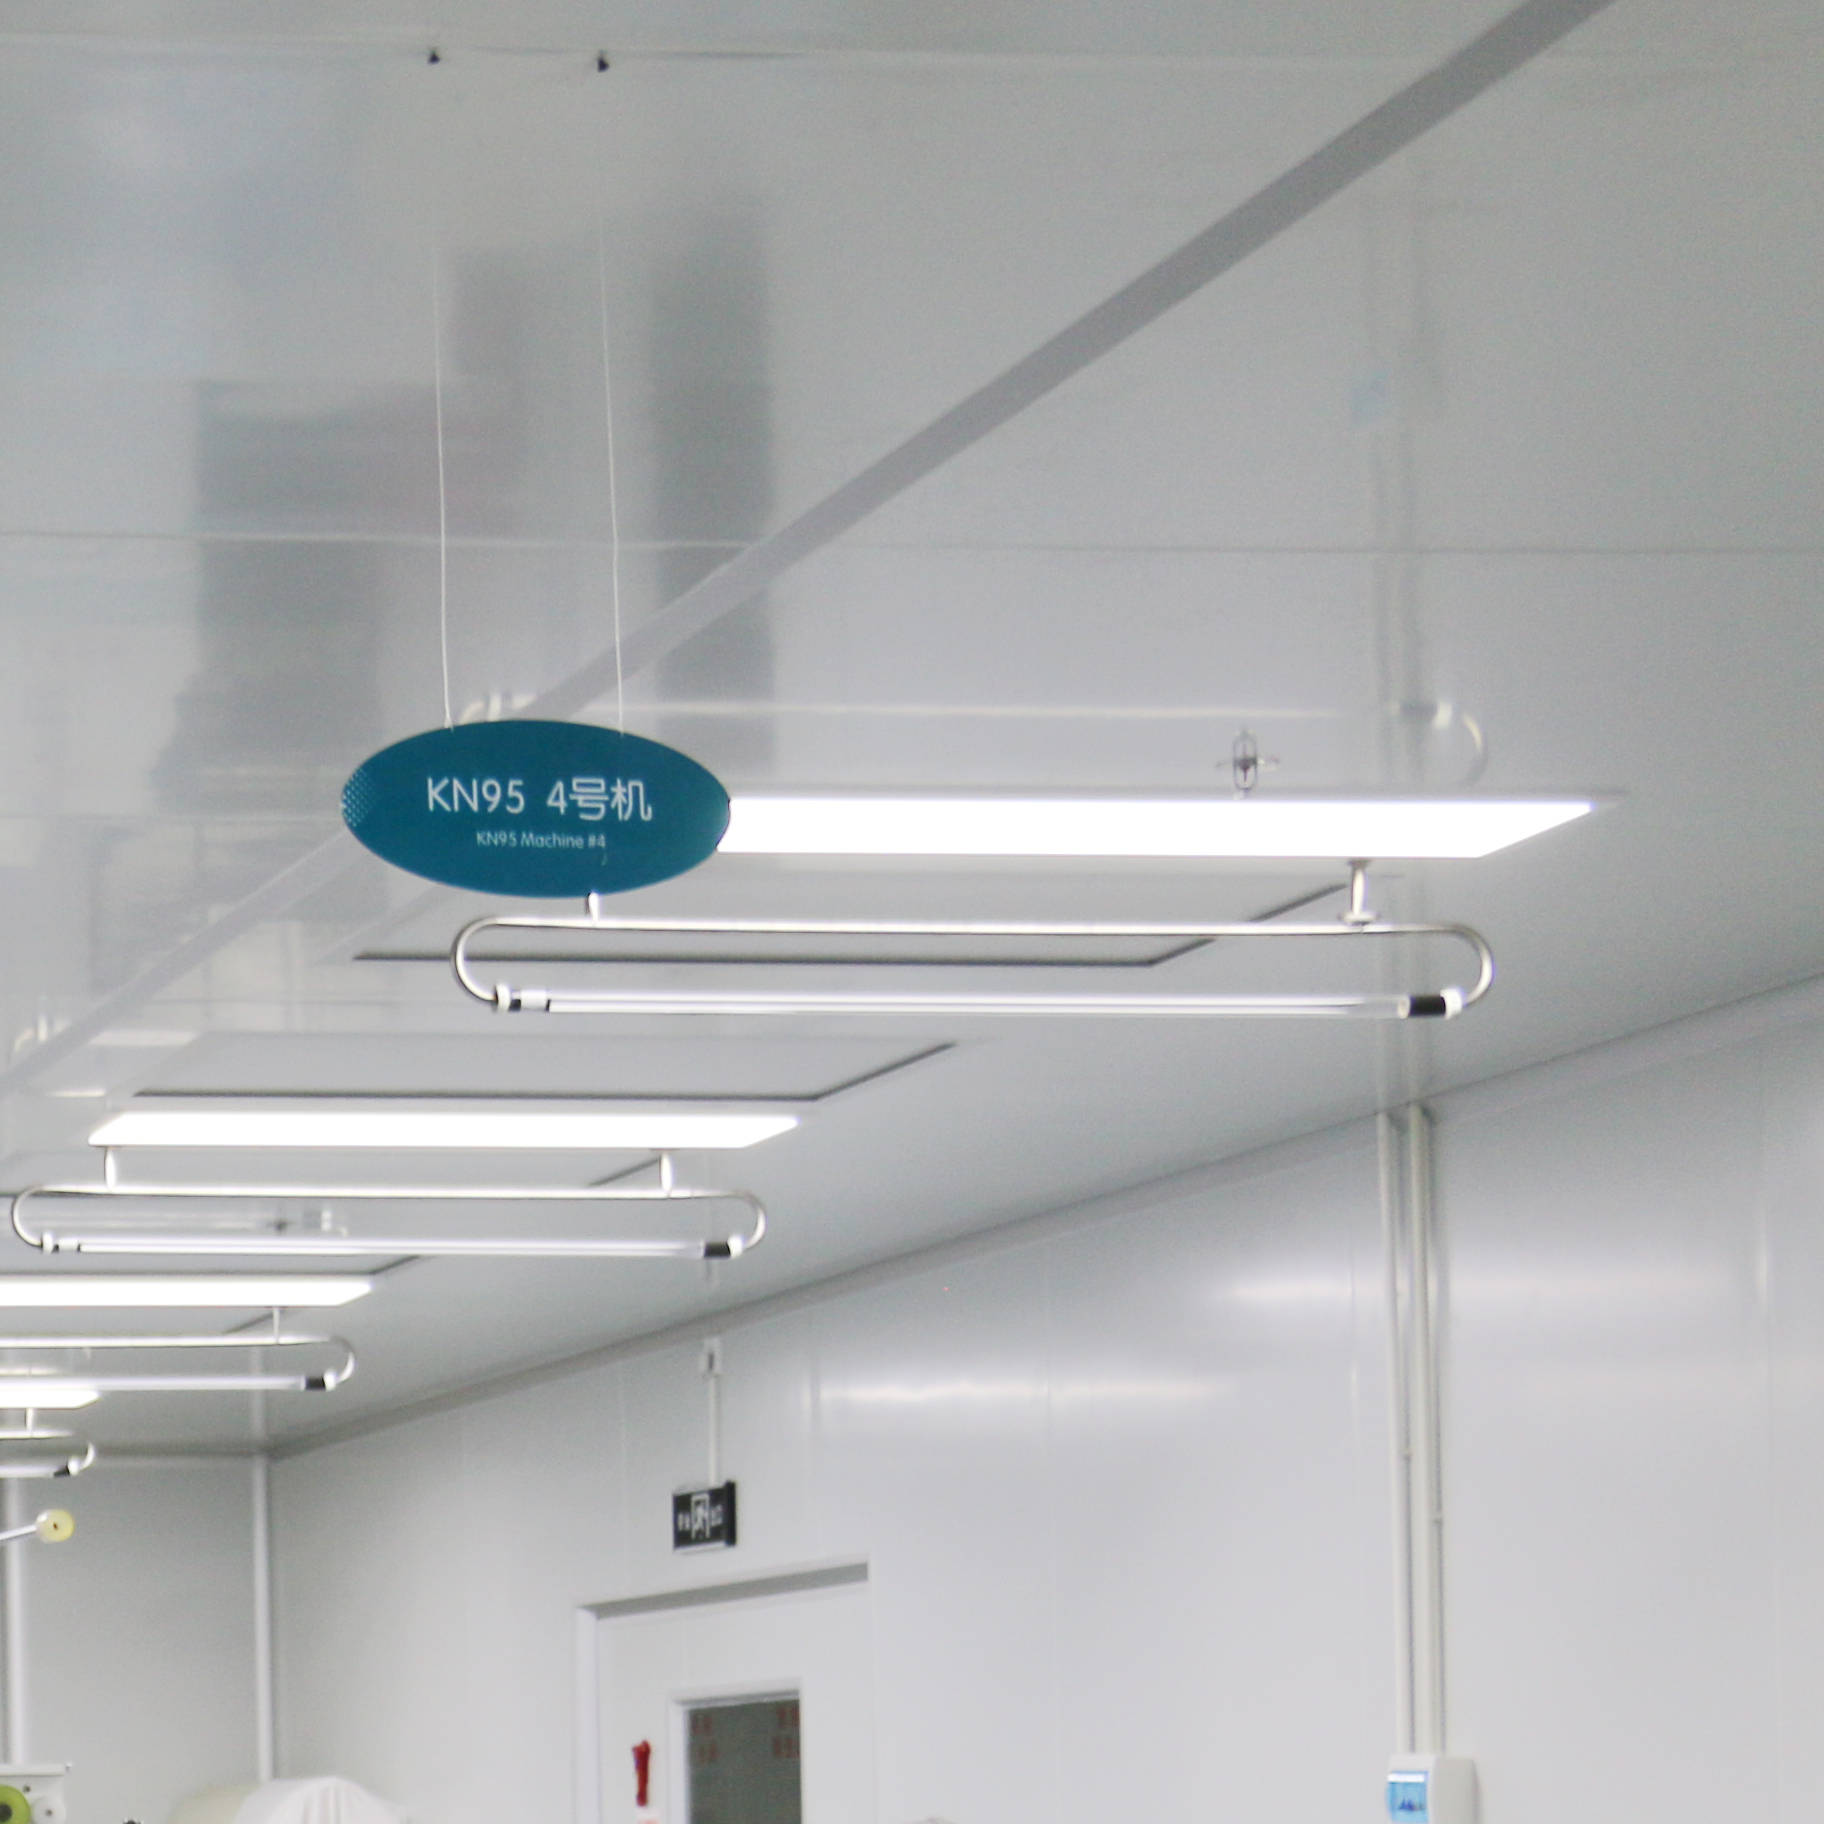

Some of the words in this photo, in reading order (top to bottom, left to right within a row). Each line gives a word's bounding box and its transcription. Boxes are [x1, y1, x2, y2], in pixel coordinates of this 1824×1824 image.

[426, 776, 525, 814] KN95
[546, 776, 652, 821] 4号机
[476, 830, 517, 847] KN95
[520, 831, 584, 849] Machine
[588, 833, 606, 849] #4
